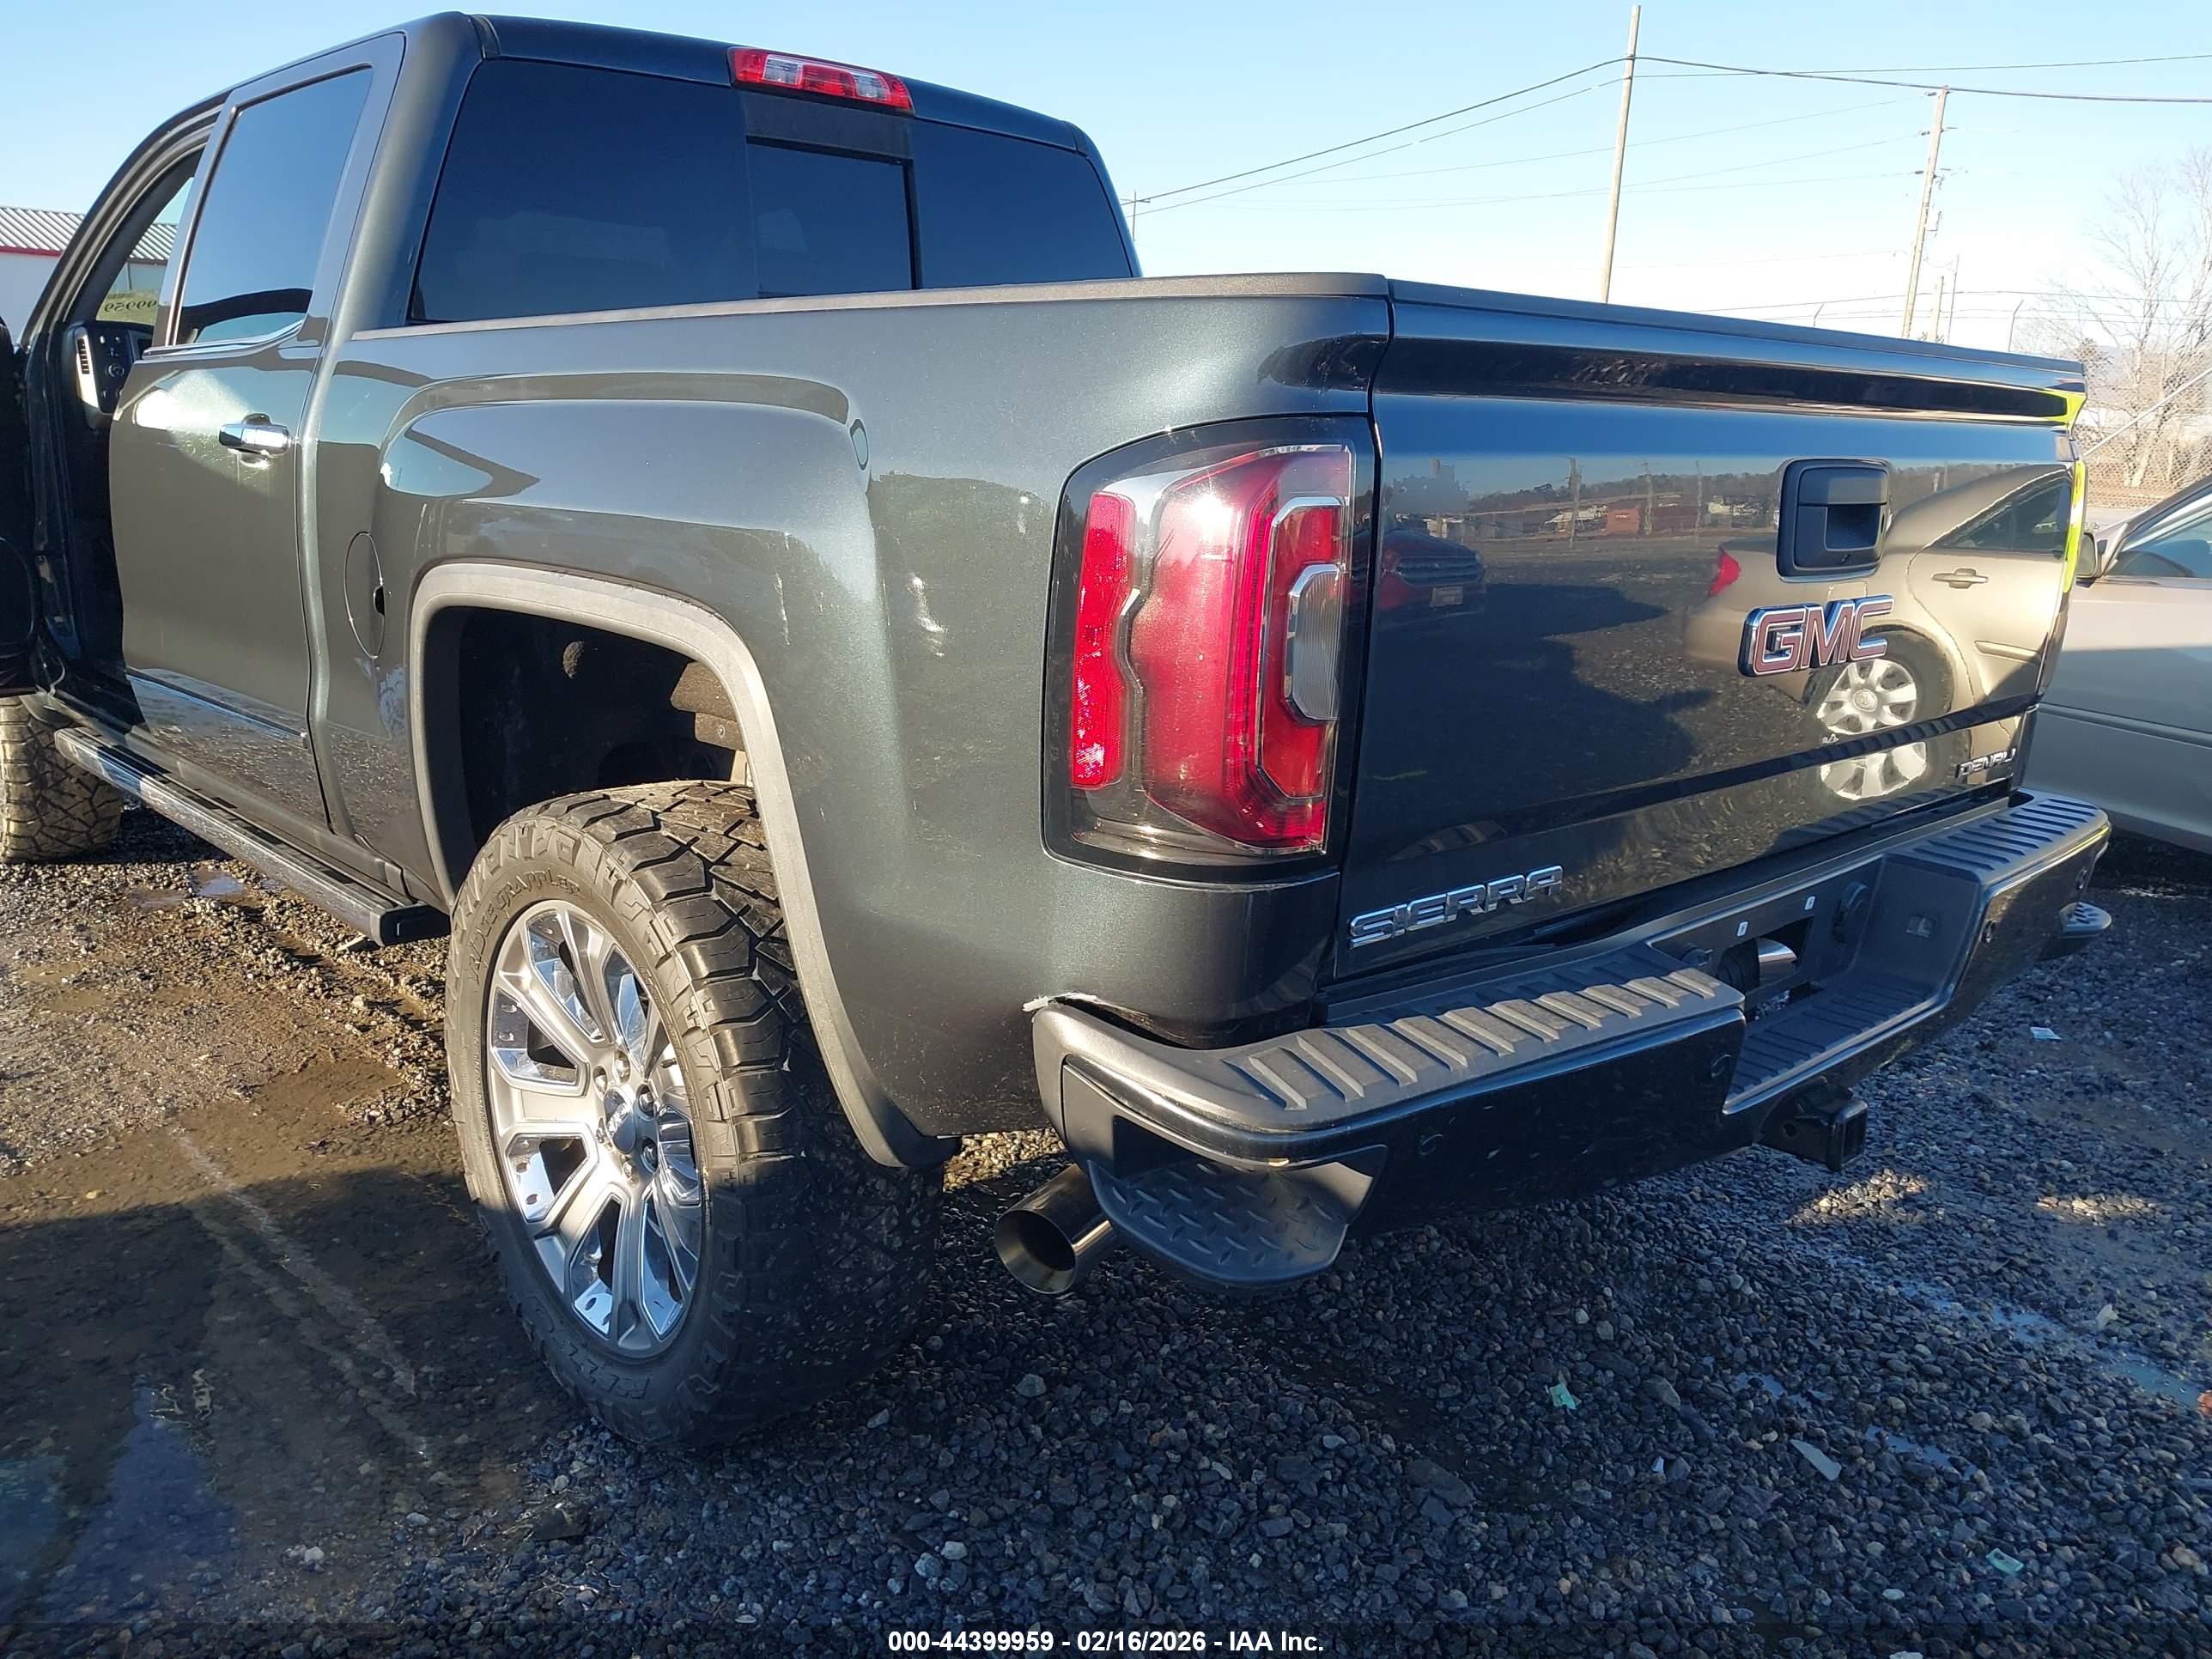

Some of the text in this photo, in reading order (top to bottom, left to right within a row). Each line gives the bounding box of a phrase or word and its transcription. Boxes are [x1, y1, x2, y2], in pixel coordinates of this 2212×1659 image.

[1738, 594, 1894, 677] GMC
[1957, 747, 2016, 779] DENALI
[1349, 865, 1563, 949] SIERRA
